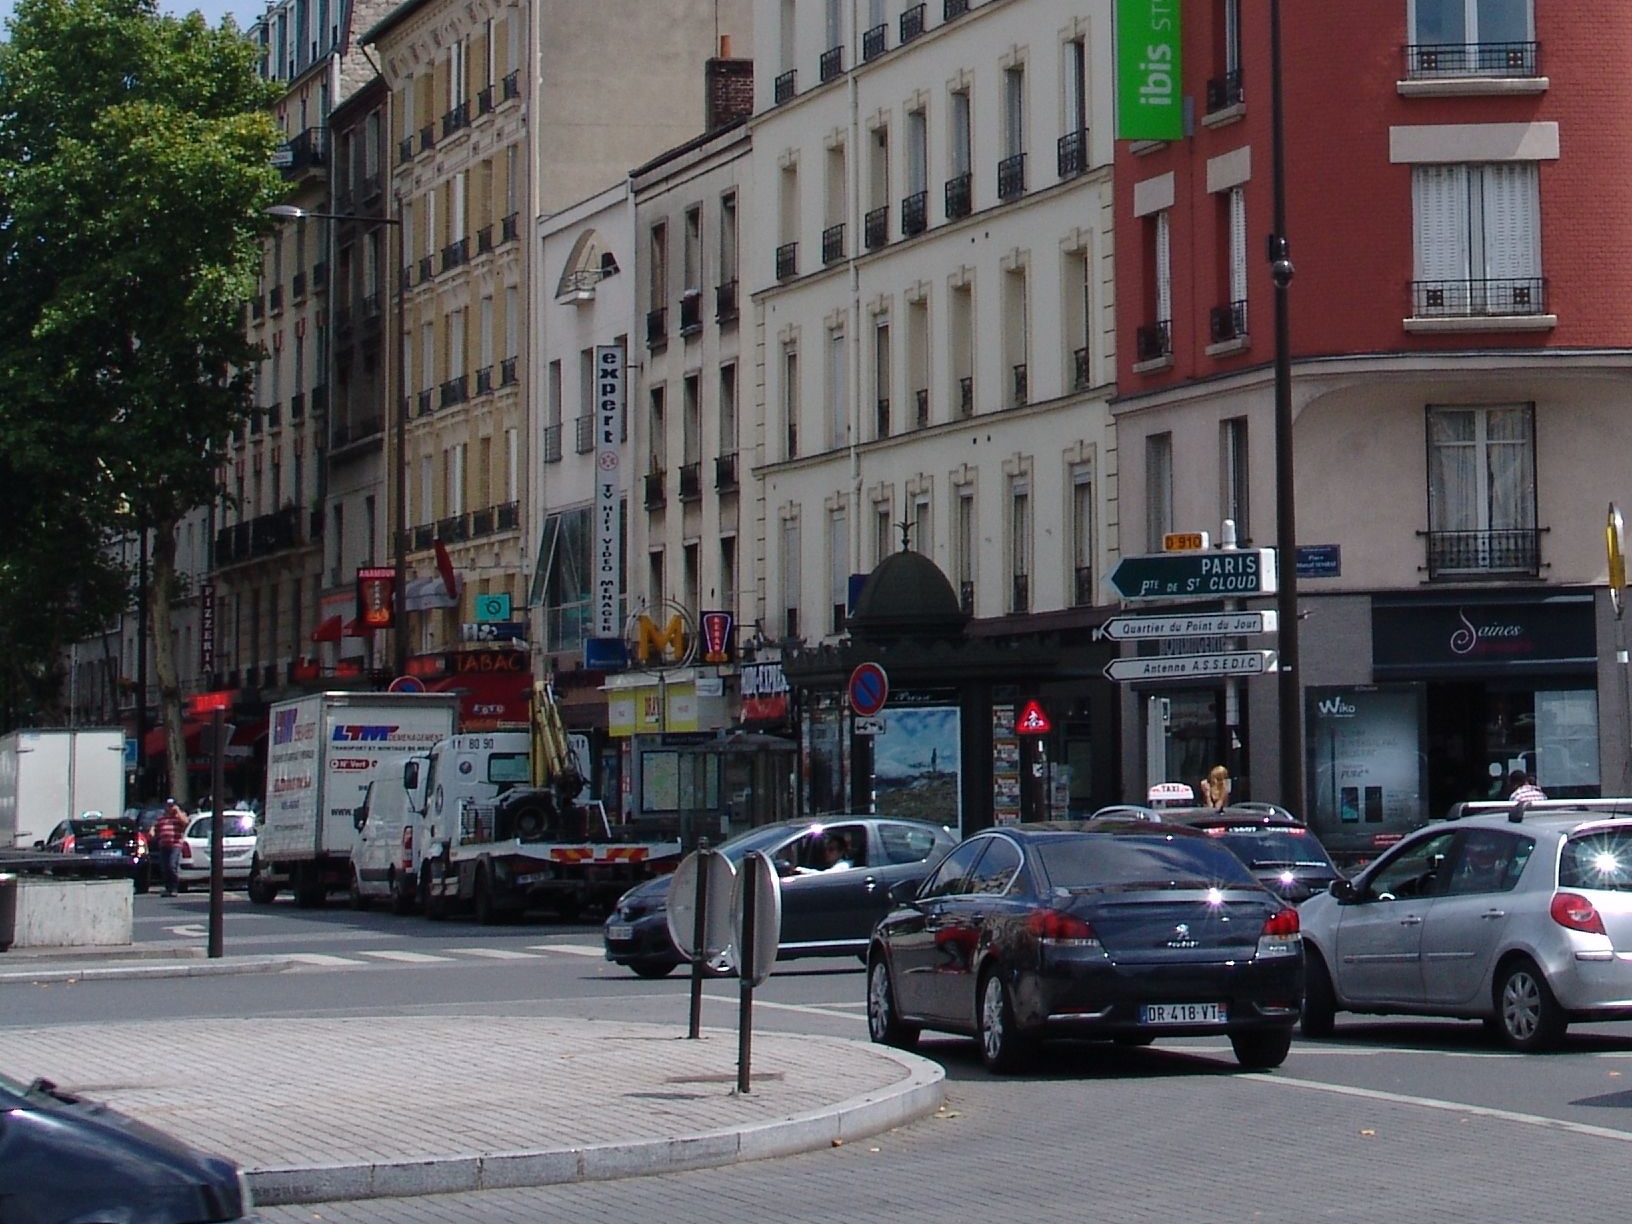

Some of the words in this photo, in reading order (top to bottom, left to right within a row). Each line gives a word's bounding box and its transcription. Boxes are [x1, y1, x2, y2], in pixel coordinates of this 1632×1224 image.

[1140, 43, 1172, 105] ibis
[600, 353, 619, 443] expert
[603, 484, 613, 499] TV
[1178, 534, 1201, 548] 910
[602, 539, 612, 572] VIDEO
[1202, 557, 1256, 574] PARIS
[1167, 583, 1178, 591] DE
[1209, 576, 1256, 590] CLOUD
[203, 586, 213, 672] PIZZERIA
[1123, 623, 1165, 634] Quartier
[1170, 622, 1181, 632] du
[1186, 620, 1212, 631] Point
[1217, 620, 1228, 630] du
[1234, 619, 1257, 630] Jour
[639, 615, 684, 664] M
[457, 655, 520, 671] TABAC
[1143, 663, 1185, 675] Antenne
[1319, 697, 1356, 714] Wiko
[333, 725, 399, 741] LTM
[483, 738, 494, 749] 90
